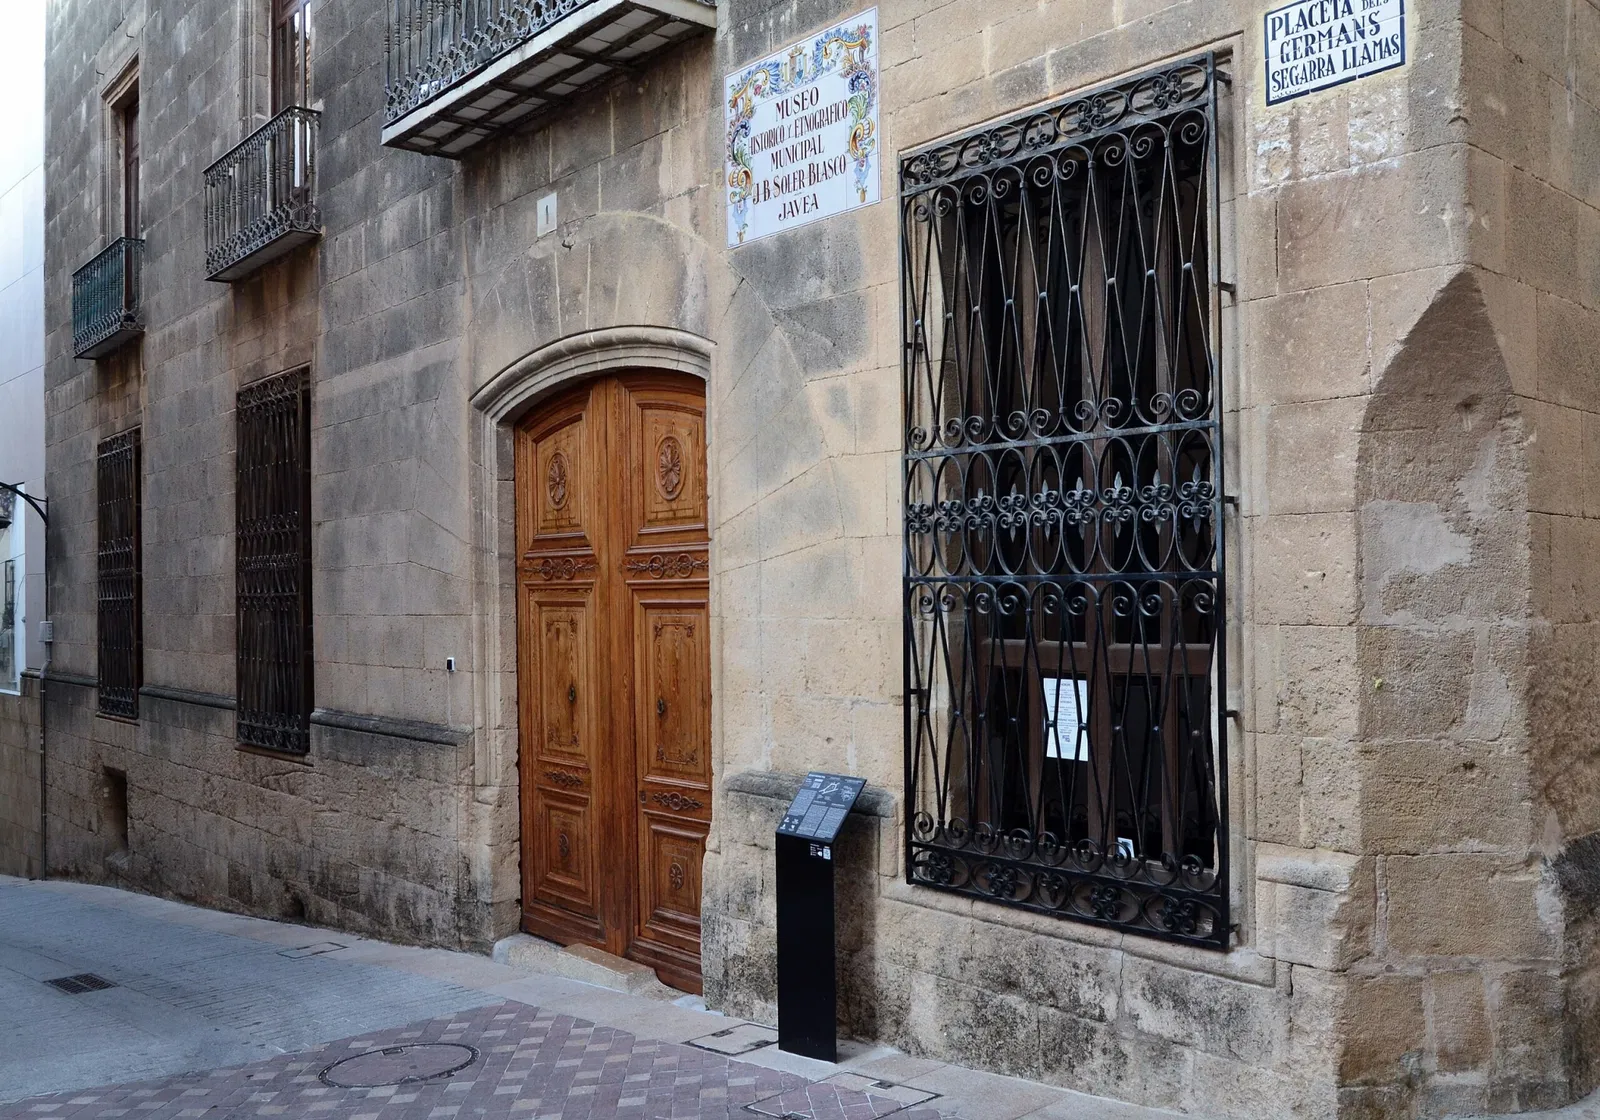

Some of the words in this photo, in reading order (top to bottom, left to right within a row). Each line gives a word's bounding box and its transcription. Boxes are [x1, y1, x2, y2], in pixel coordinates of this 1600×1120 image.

[1270, 0, 1354, 42] PLACETA
[1360, 0, 1389, 12] DEL
[1280, 10, 1380, 64] GERMANS
[1271, 53, 1336, 93] SEGARRA
[1342, 33, 1400, 73] LLAMAS
[776, 86, 819, 122] MUSEO
[750, 124, 785, 155] HISTORICO
[786, 124, 793, 139] Y
[794, 99, 848, 139] ETNOGRAFICO
[771, 134, 825, 172] MUNICIPAL
[773, 168, 805, 198] SOLER
[808, 154, 847, 187] BLASCO
[778, 193, 819, 221] JAVEA
